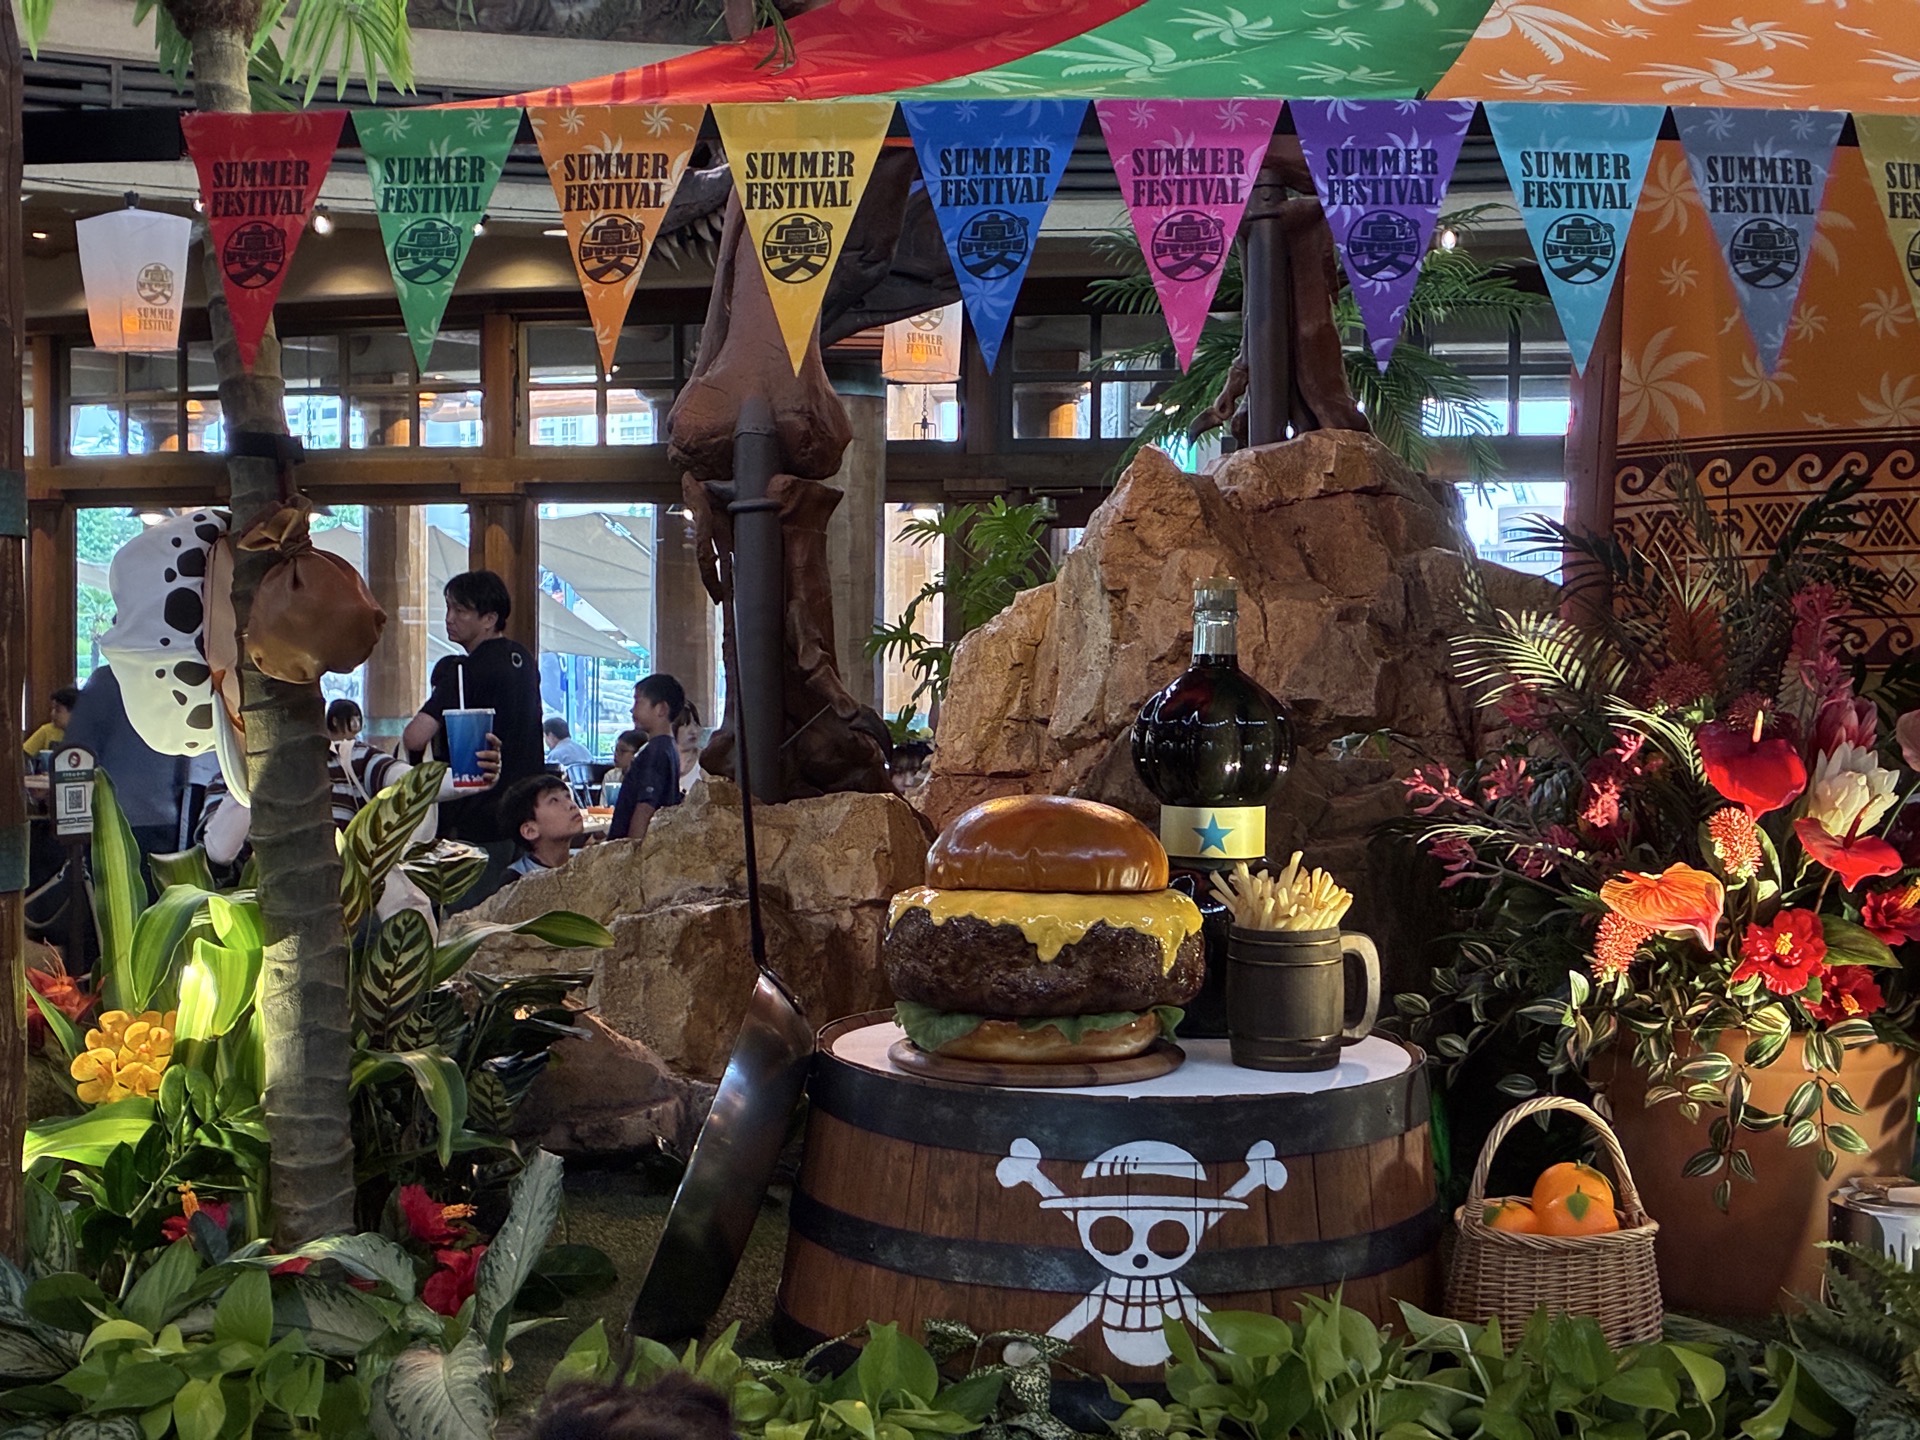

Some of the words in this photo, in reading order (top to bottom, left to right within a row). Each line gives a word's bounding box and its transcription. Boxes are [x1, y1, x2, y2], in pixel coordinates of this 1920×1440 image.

[213, 160, 310, 188] SUMMER
[384, 156, 486, 185] SUMMER
[564, 153, 669, 181] SUMMER
[745, 151, 855, 179] SUMMER
[940, 147, 1051, 176] SUMMER
[1132, 148, 1245, 176] SUMMER
[1326, 147, 1438, 175] SUMMER
[1520, 151, 1631, 179] SUMMER
[1706, 155, 1813, 185] SUMMER
[211, 189, 306, 217] FESTIVAL
[381, 186, 482, 214] FESTIVAL
[564, 182, 665, 212] FESTIVAL
[745, 180, 853, 210] FESTIVAL
[940, 177, 1049, 207] FESTIVAL
[1132, 178, 1244, 207] FESTIVAL
[1327, 178, 1439, 206] FESTIVAL
[1523, 180, 1632, 209] FESTIVAL
[1708, 186, 1814, 215] FESTIVAL
[765, 242, 828, 257] UTAGE
[1546, 243, 1612, 256] UTAGE
[137, 307, 174, 319] SUMMER
[906, 332, 943, 345] SUMMER
[906, 343, 943, 356] FESTIVAL
